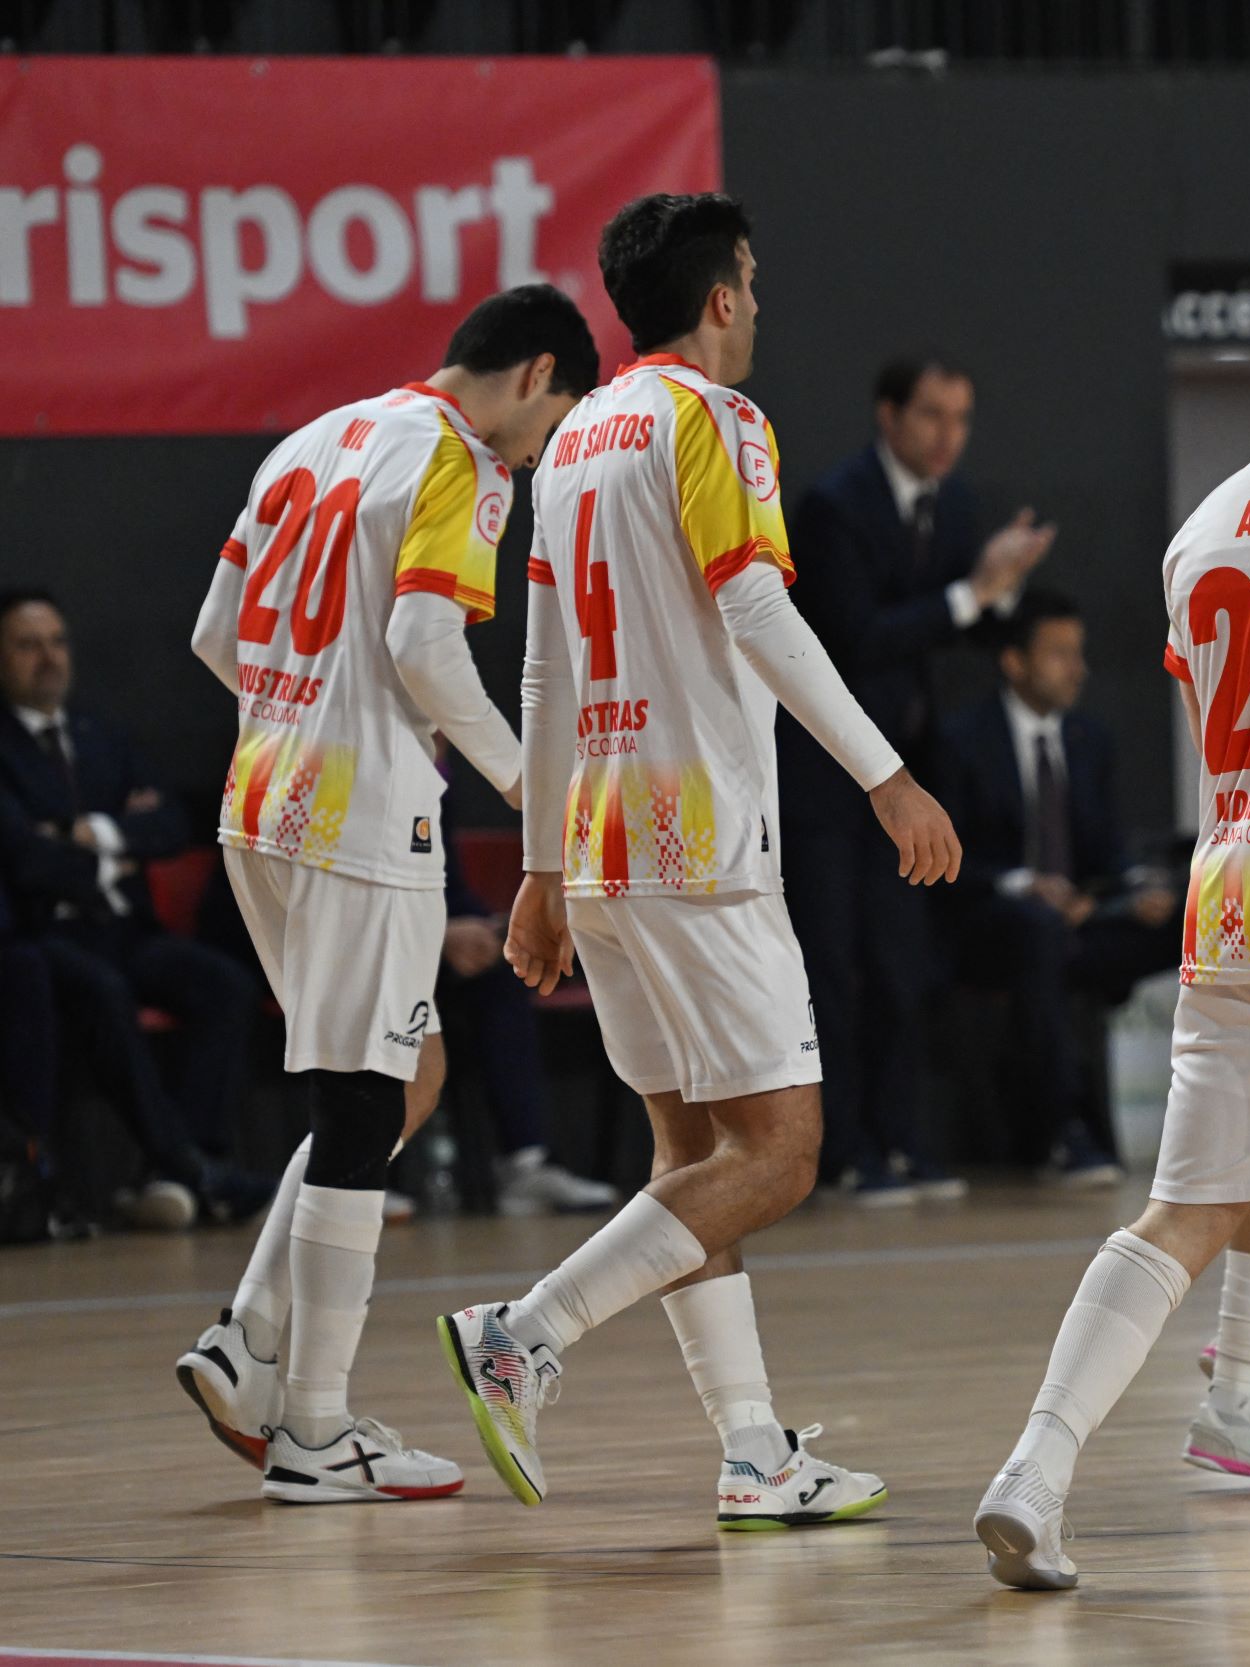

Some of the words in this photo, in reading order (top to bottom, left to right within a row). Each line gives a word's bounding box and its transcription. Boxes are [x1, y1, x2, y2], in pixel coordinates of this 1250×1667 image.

[0, 142, 555, 341] risport
[238, 466, 360, 657] 20
[574, 488, 618, 682] 4
